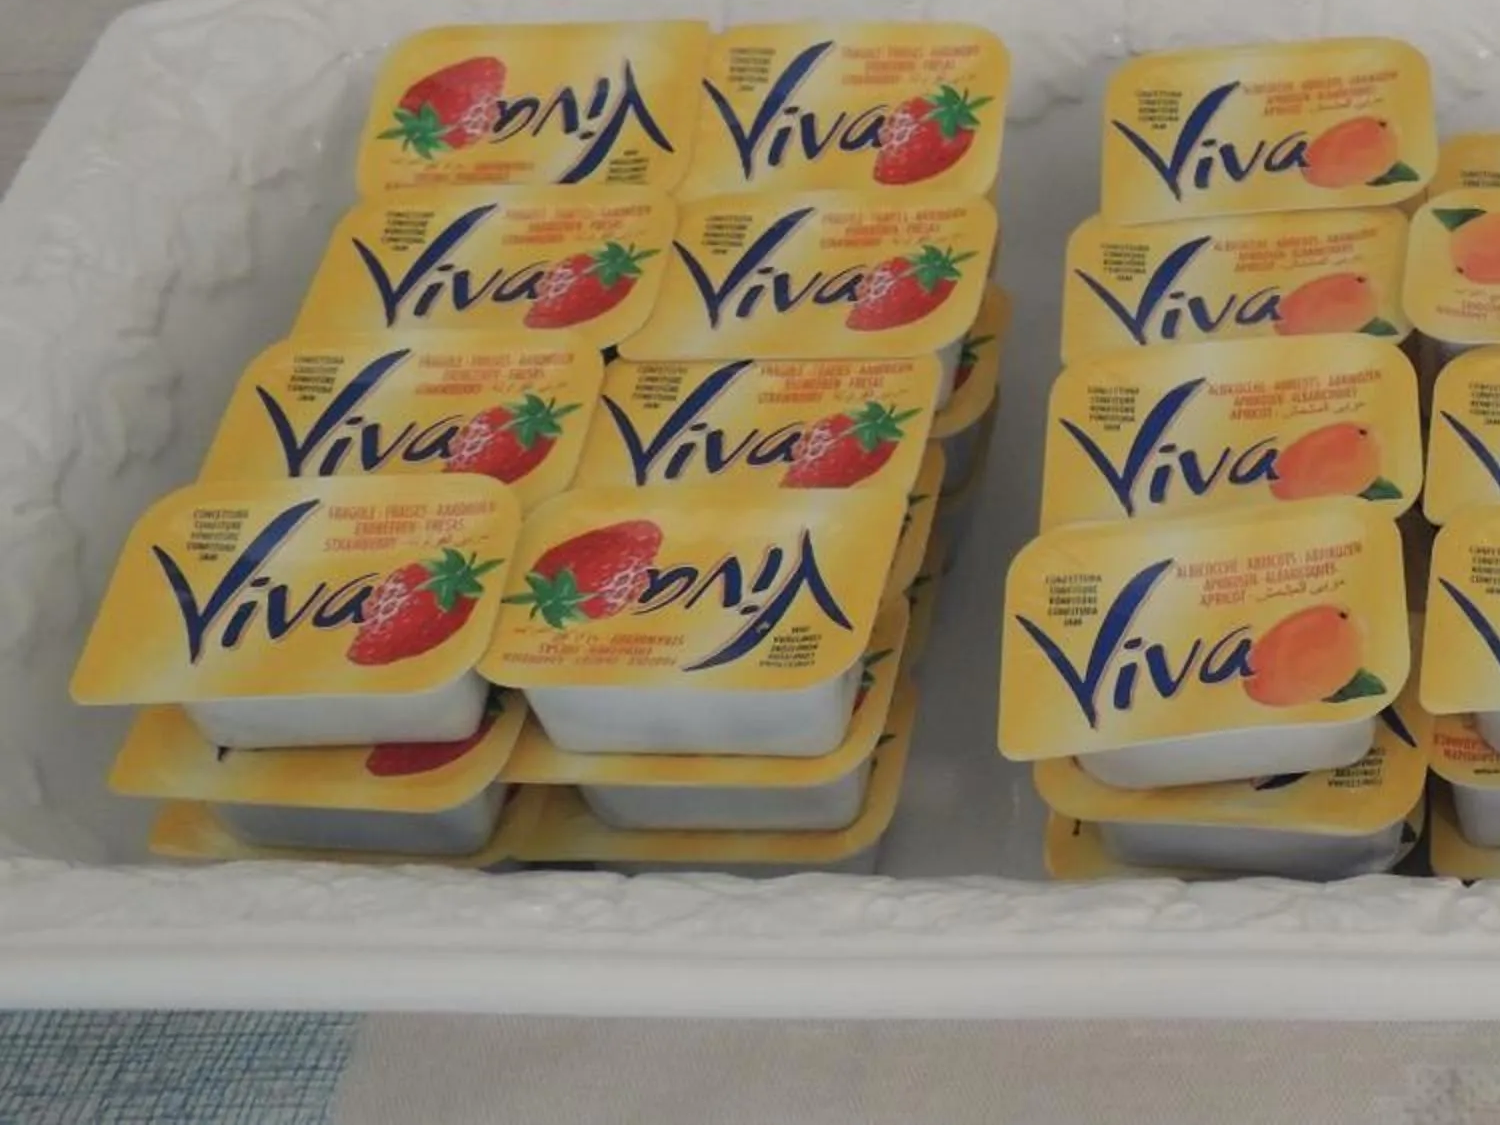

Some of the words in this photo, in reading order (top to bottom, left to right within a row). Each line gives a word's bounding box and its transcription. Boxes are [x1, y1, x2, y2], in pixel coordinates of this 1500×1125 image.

[490, 59, 674, 184] Viva
[702, 40, 889, 180] Viva
[1111, 80, 1310, 203] Viva
[352, 203, 550, 327] Viva
[672, 207, 868, 330] Viva
[1074, 236, 1282, 345] Viva
[256, 348, 463, 477] Viva
[601, 359, 804, 486] Viva
[1059, 377, 1280, 517] Viva
[153, 498, 379, 664] Viva
[634, 529, 853, 672] Viva
[1015, 558, 1257, 728] Viva
